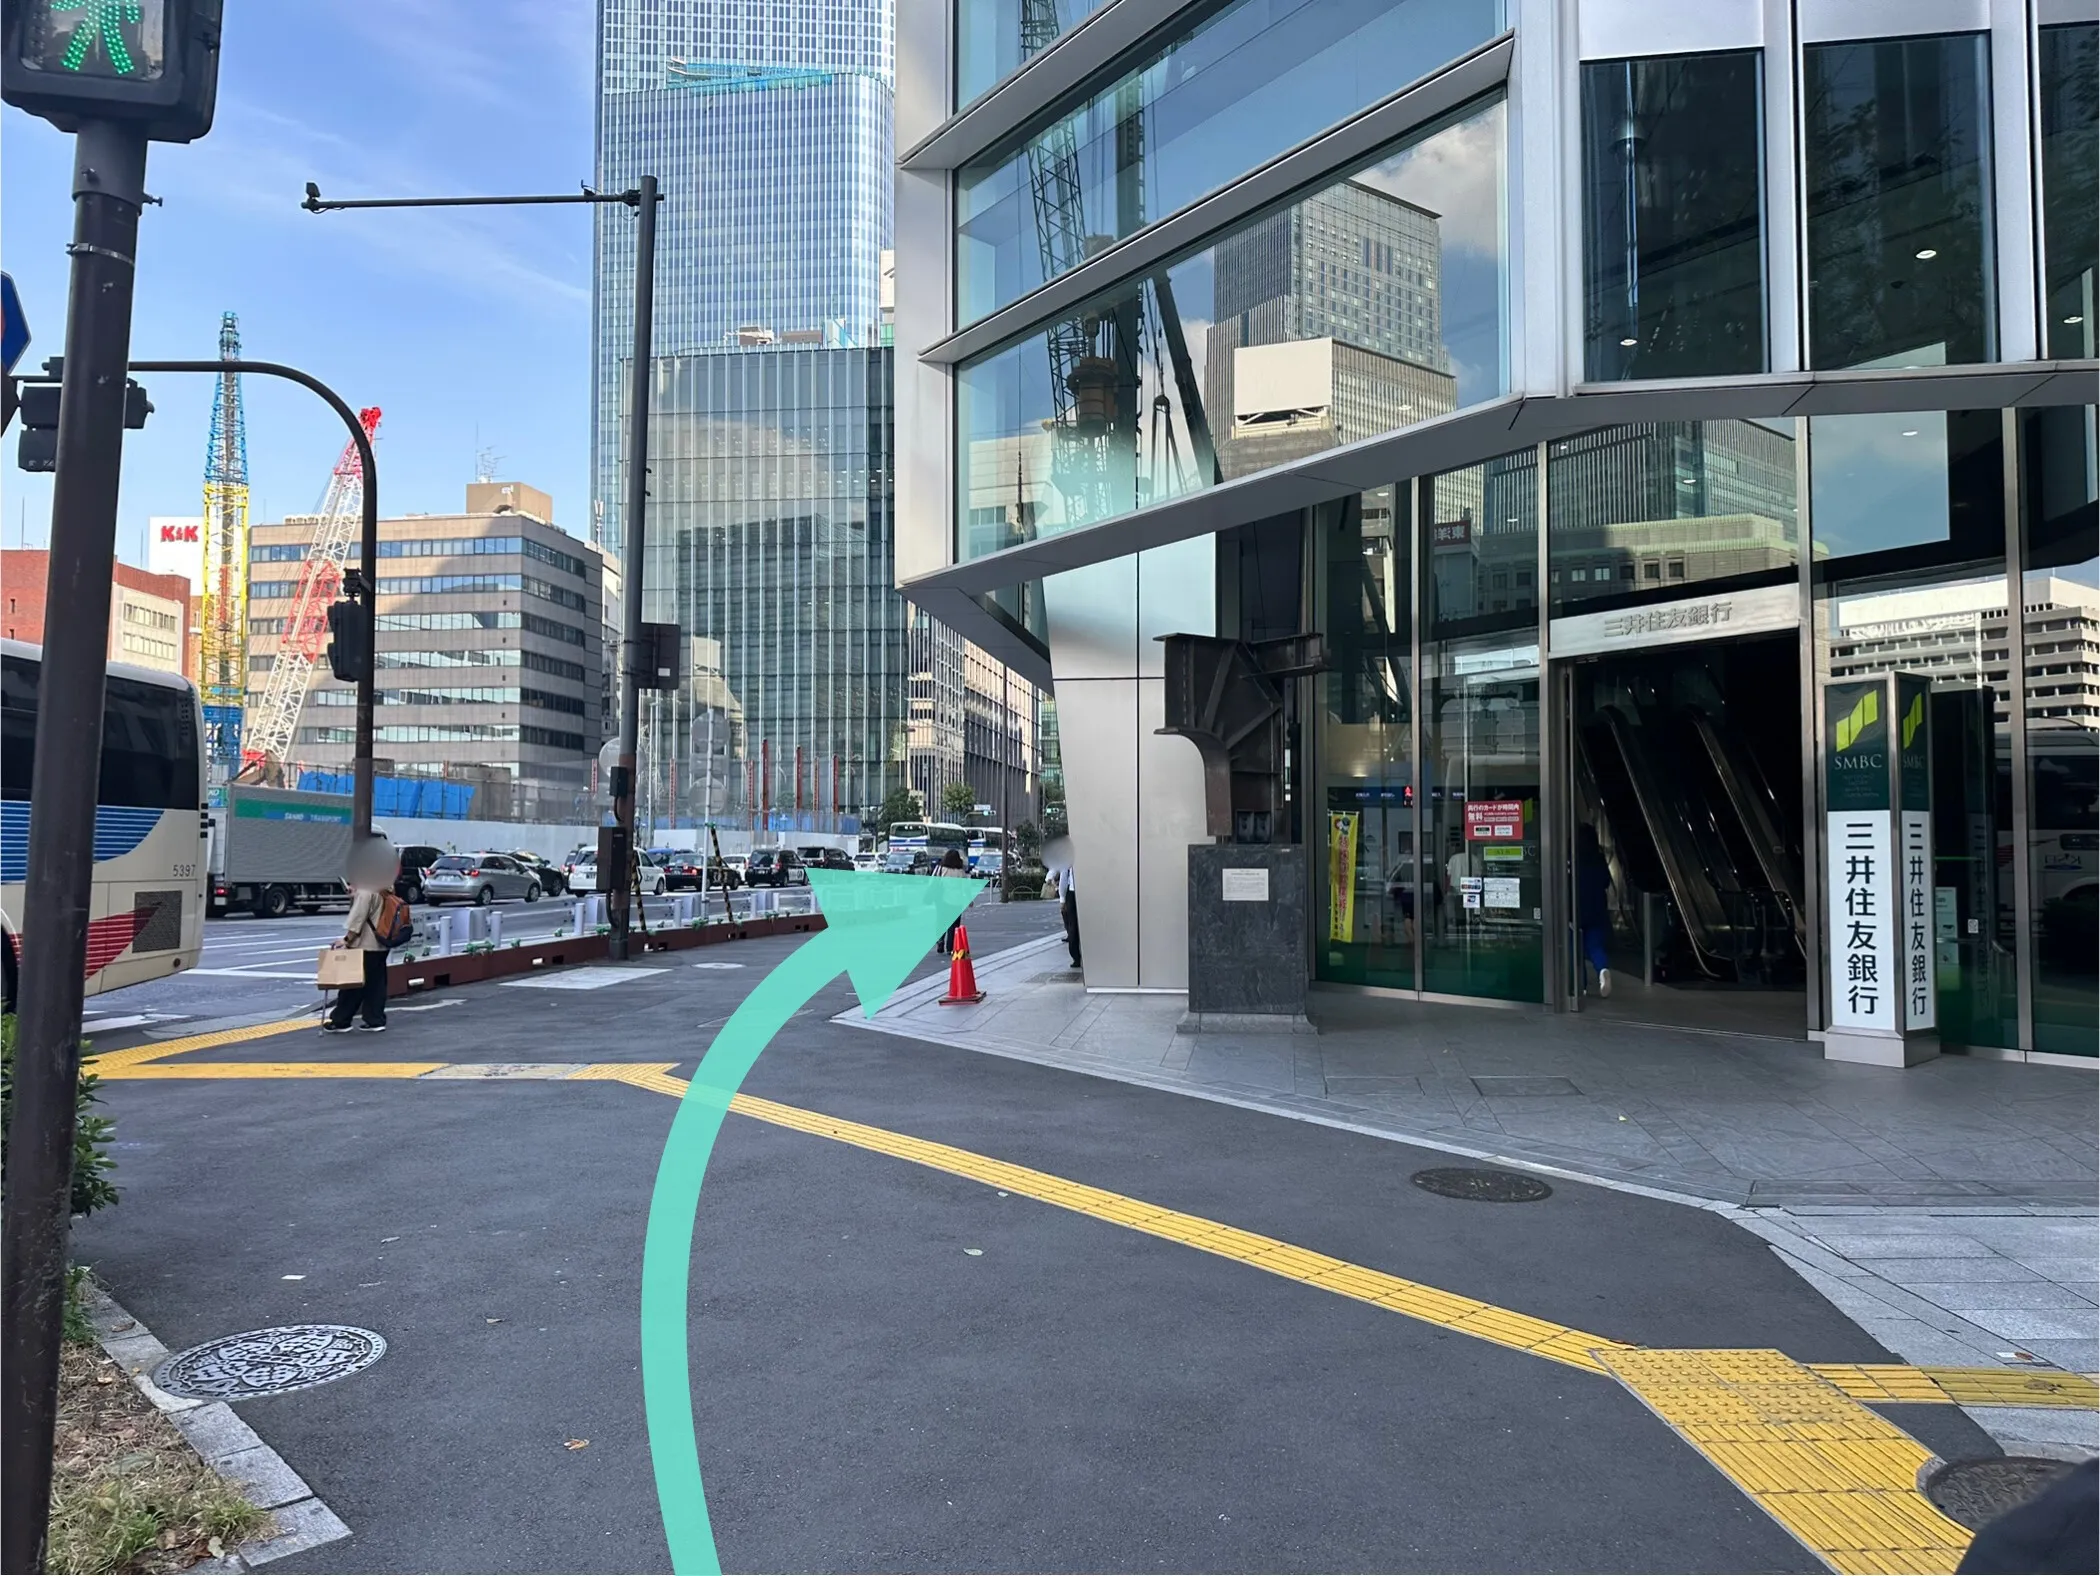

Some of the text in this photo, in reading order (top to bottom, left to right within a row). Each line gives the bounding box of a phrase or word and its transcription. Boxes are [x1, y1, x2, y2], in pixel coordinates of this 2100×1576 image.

[1604, 601, 1733, 637] 三井住友銀行
[1834, 754, 1882, 770] SMBC
[173, 864, 196, 877] 5397
[1845, 822, 1879, 1015] 三井住友銀行
[1908, 823, 1927, 1016] 三井住友銀行
